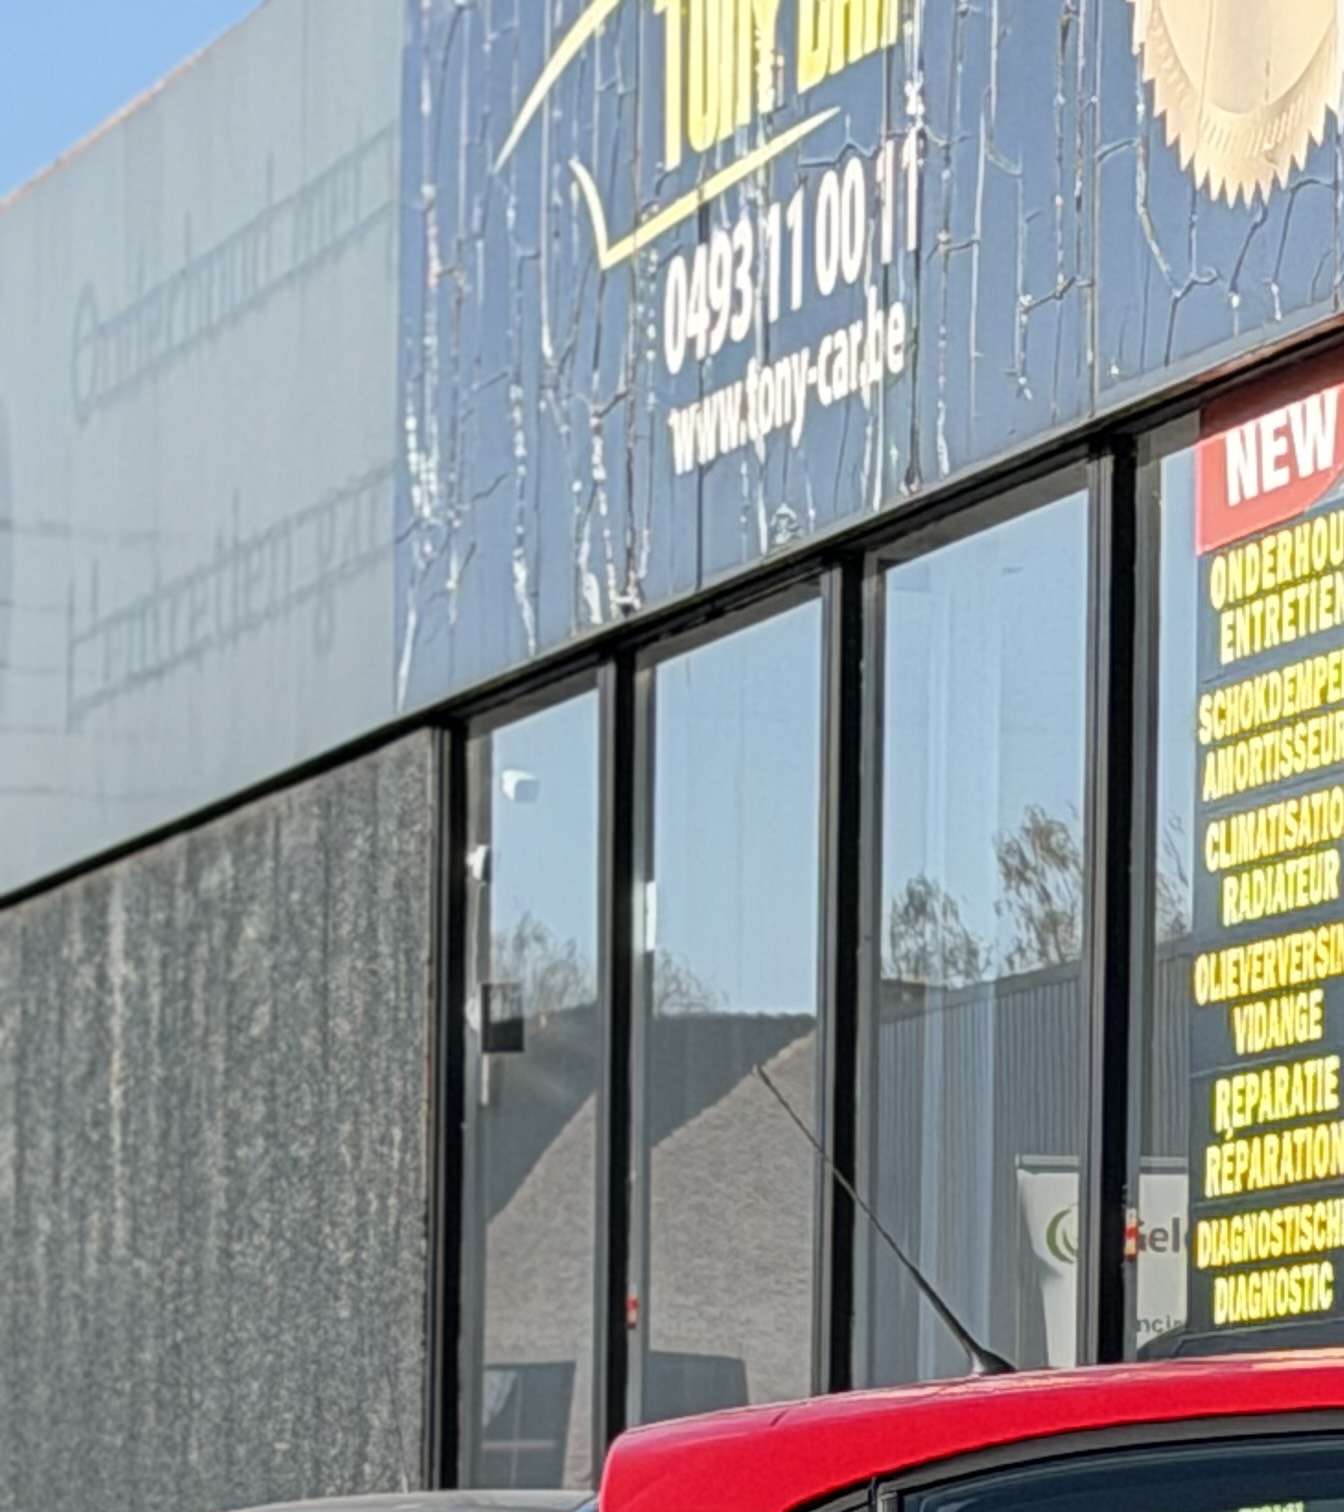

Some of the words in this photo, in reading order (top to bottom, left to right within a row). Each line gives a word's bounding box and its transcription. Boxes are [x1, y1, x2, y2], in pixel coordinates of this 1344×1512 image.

[664, 212, 754, 375] 0493
[766, 188, 804, 323] 11
[815, 157, 866, 296] 00
[876, 132, 919, 264] 11
[667, 286, 906, 476] www.tony-car.be
[1225, 388, 1339, 507] NEW
[1222, 848, 1340, 928] RADIATEUR
[1233, 989, 1324, 1056] VIDANGE
[1215, 1055, 1340, 1132] REPARATIE
[1213, 1262, 1334, 1327] DIAGNOSTIC
